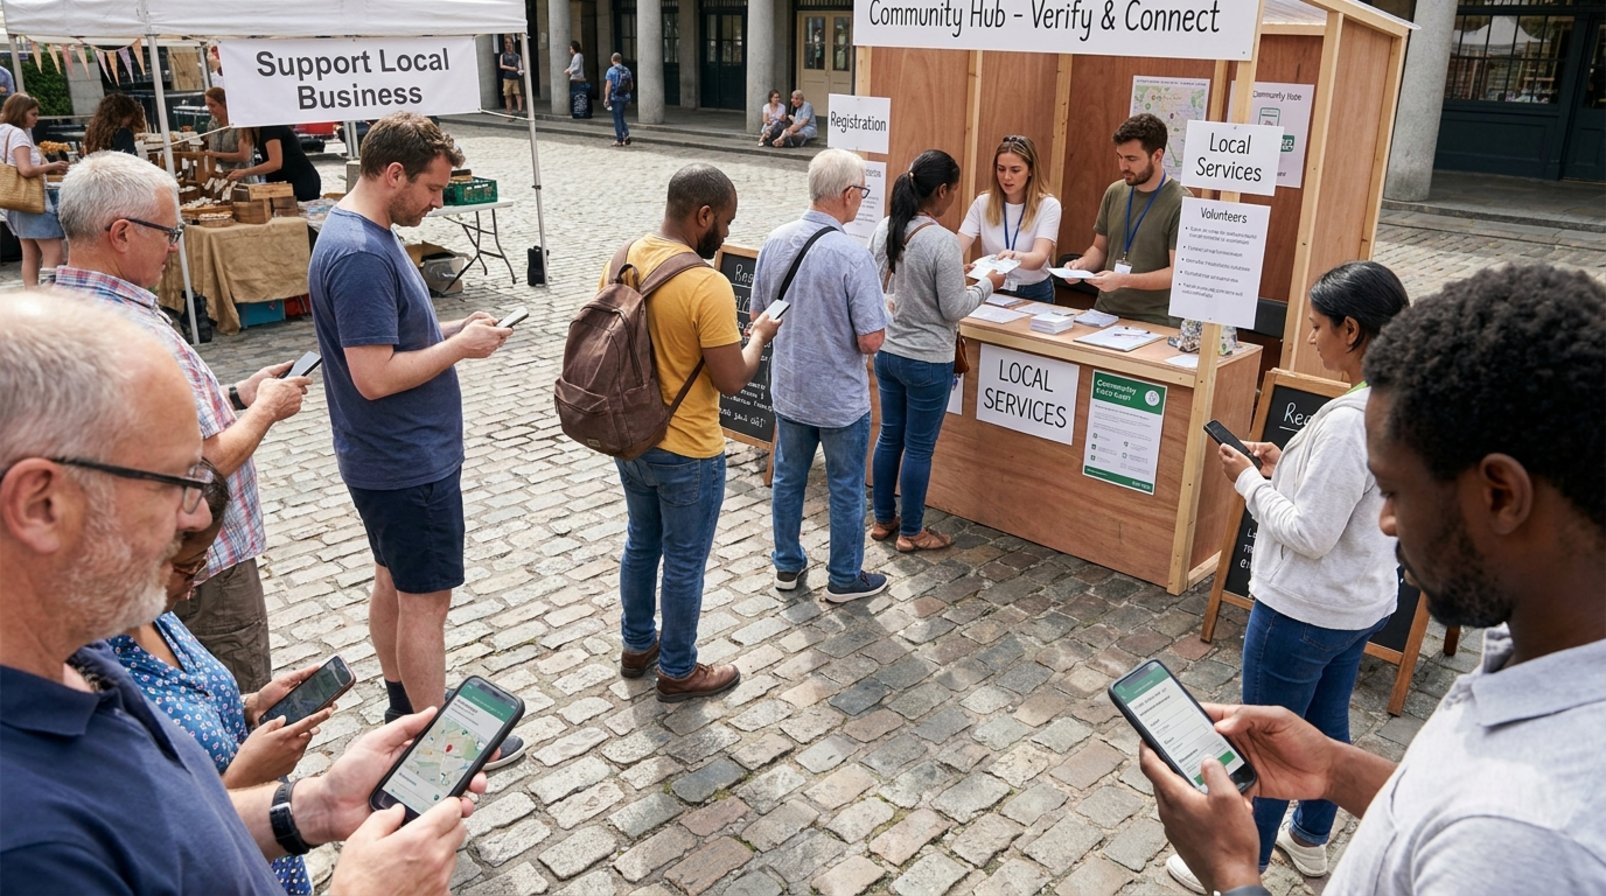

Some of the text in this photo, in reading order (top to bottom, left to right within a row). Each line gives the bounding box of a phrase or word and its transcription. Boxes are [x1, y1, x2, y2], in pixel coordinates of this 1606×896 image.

[869, 0, 963, 38] Community
[970, 0, 1006, 28] Hub
[1031, 0, 1092, 42] Verify
[1100, 0, 1116, 31] &
[1125, 0, 1221, 33] Connect
[256, 47, 450, 82] Support Local
[297, 83, 423, 110] Business
[830, 111, 887, 133] Registration
[1209, 132, 1252, 155] Local
[1195, 156, 1262, 182] Services
[1200, 206, 1248, 224] Volunteers
[999, 359, 1054, 393] LOCAL
[983, 387, 1067, 429] SERVICES
